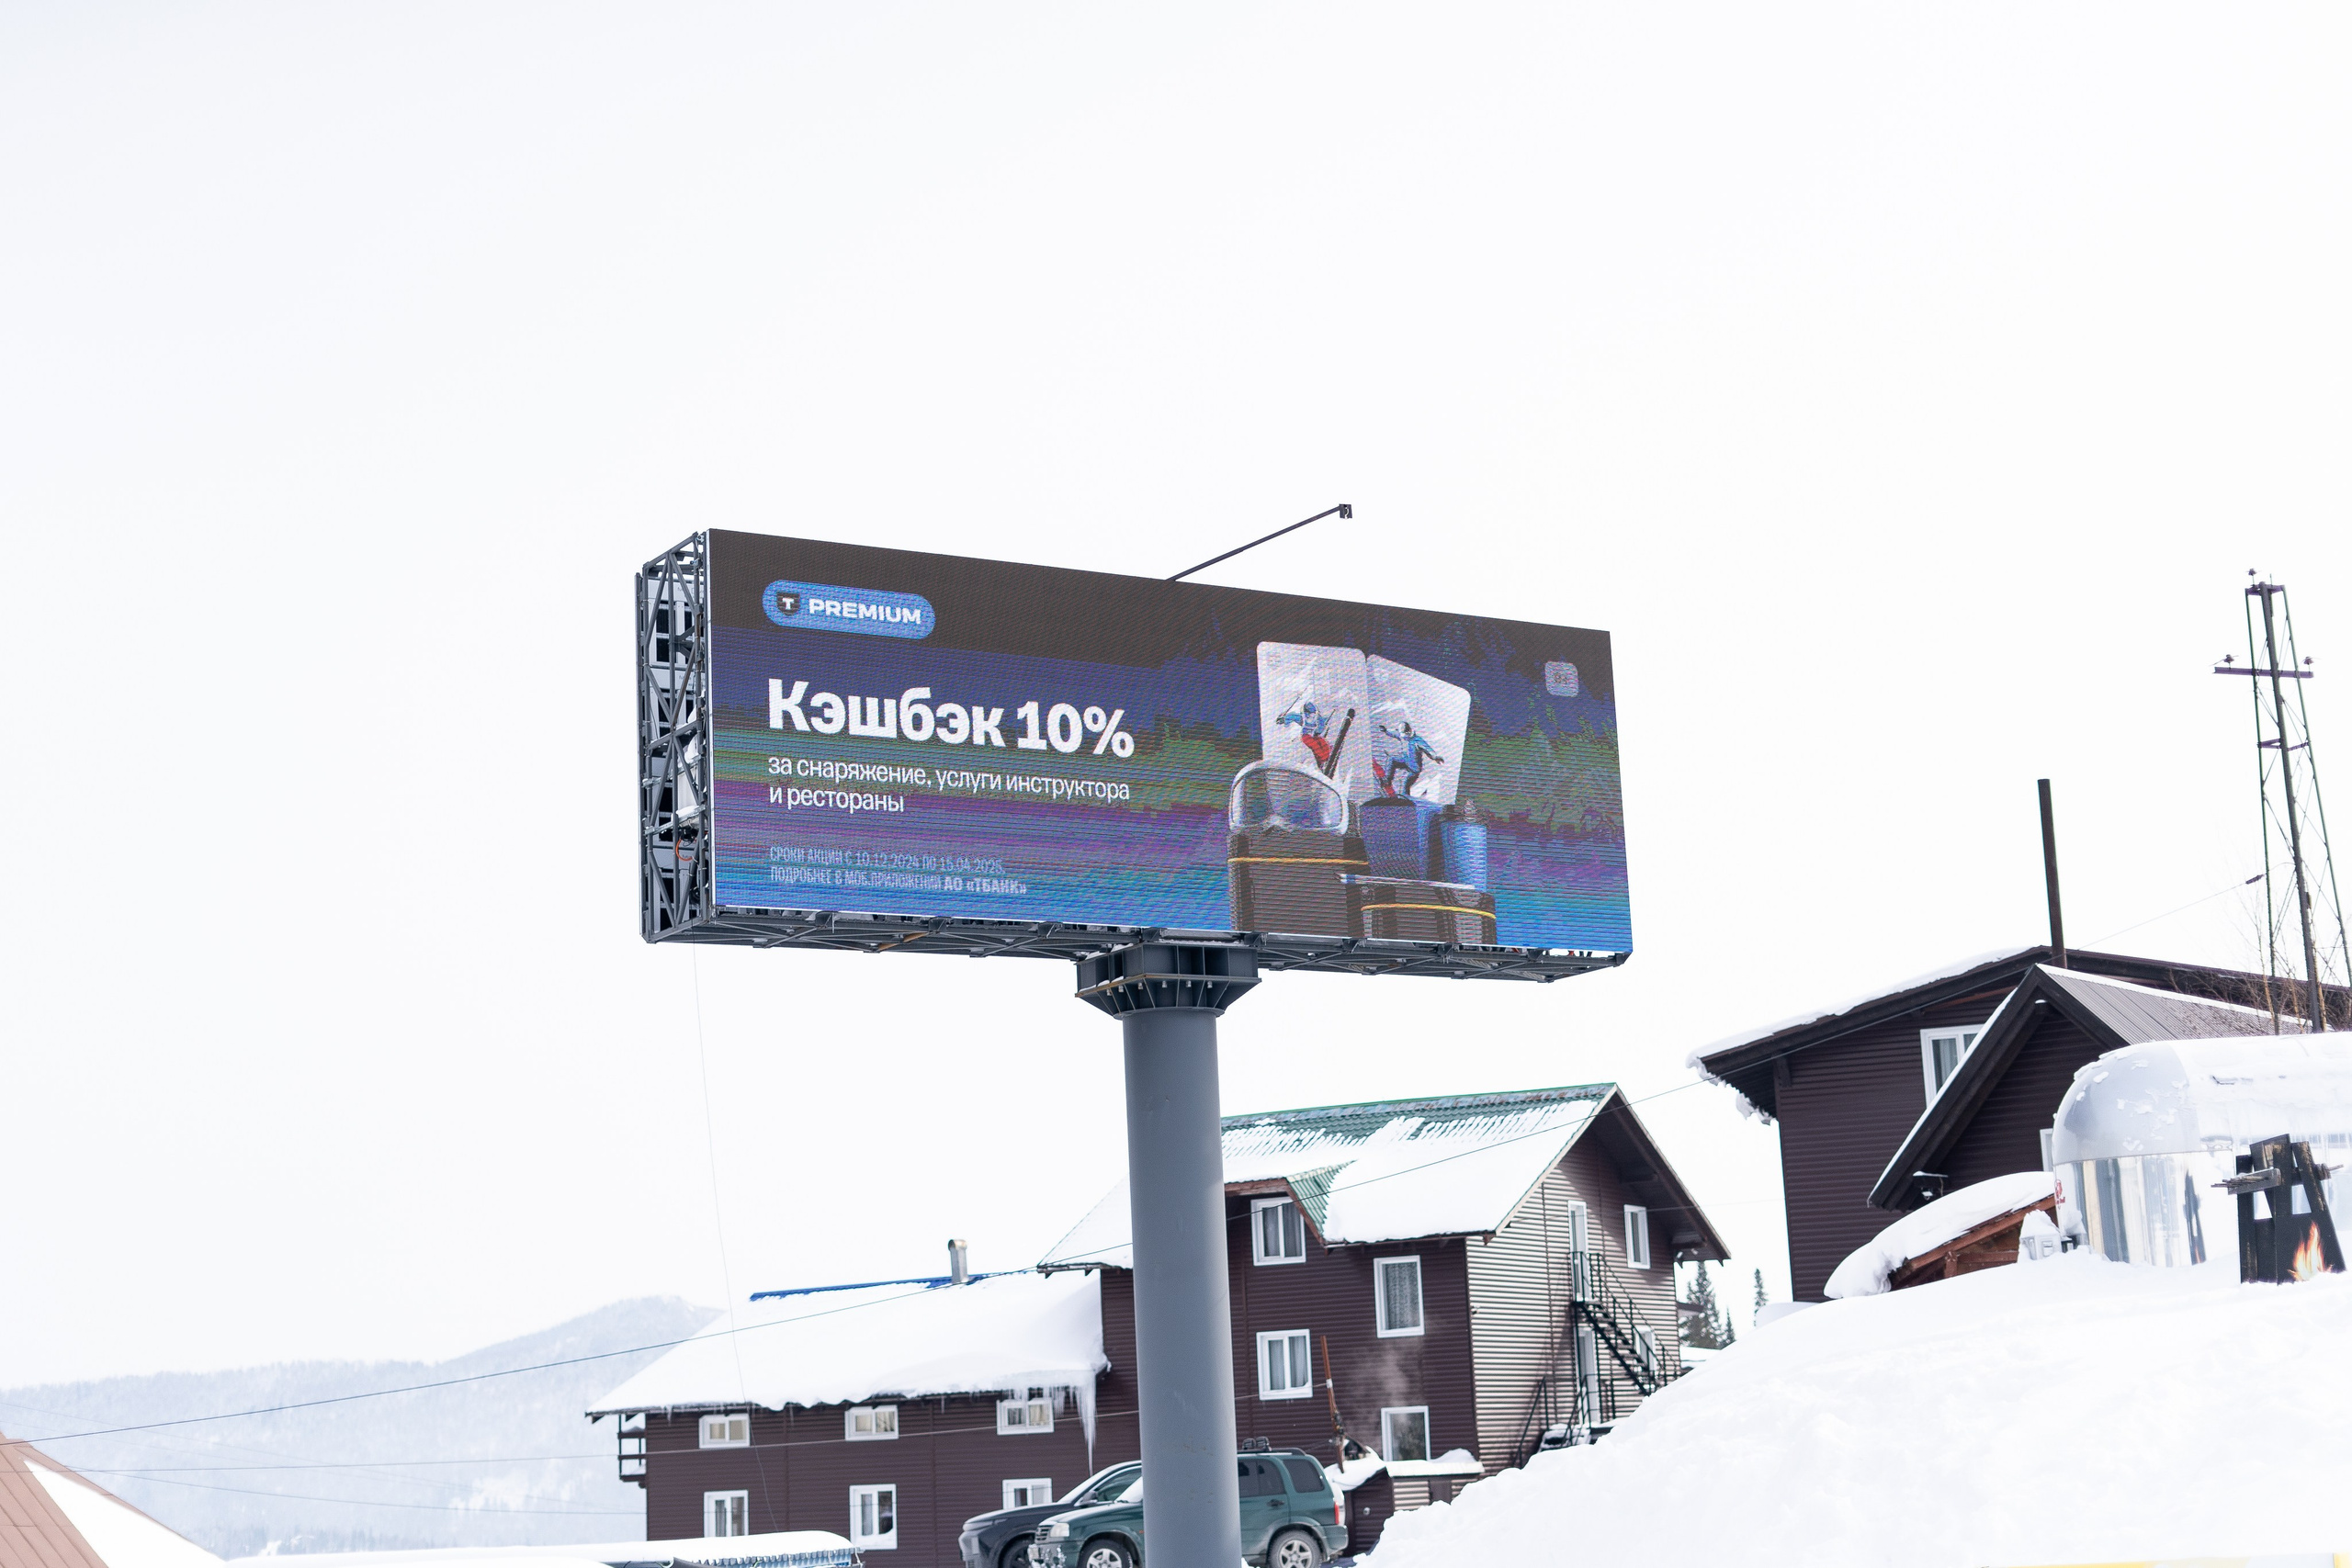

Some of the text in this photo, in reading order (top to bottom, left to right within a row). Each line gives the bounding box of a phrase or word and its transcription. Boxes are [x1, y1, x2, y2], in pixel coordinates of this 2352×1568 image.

[808, 598, 922, 625] PREMIUM
[768, 678, 1136, 759] Кэшбэк 10%
[768, 757, 1130, 804] за снаряжение, услуги инструктора
[769, 788, 905, 814] и рестораны
[770, 846, 805, 863] СРОКИ
[808, 848, 842, 865] АКЦИИ
[844, 851, 852, 864] С
[922, 855, 937, 870] ПО
[771, 866, 831, 884] ПОДРОБНЕЕ
[834, 870, 842, 884] В
[944, 876, 964, 891] АО
